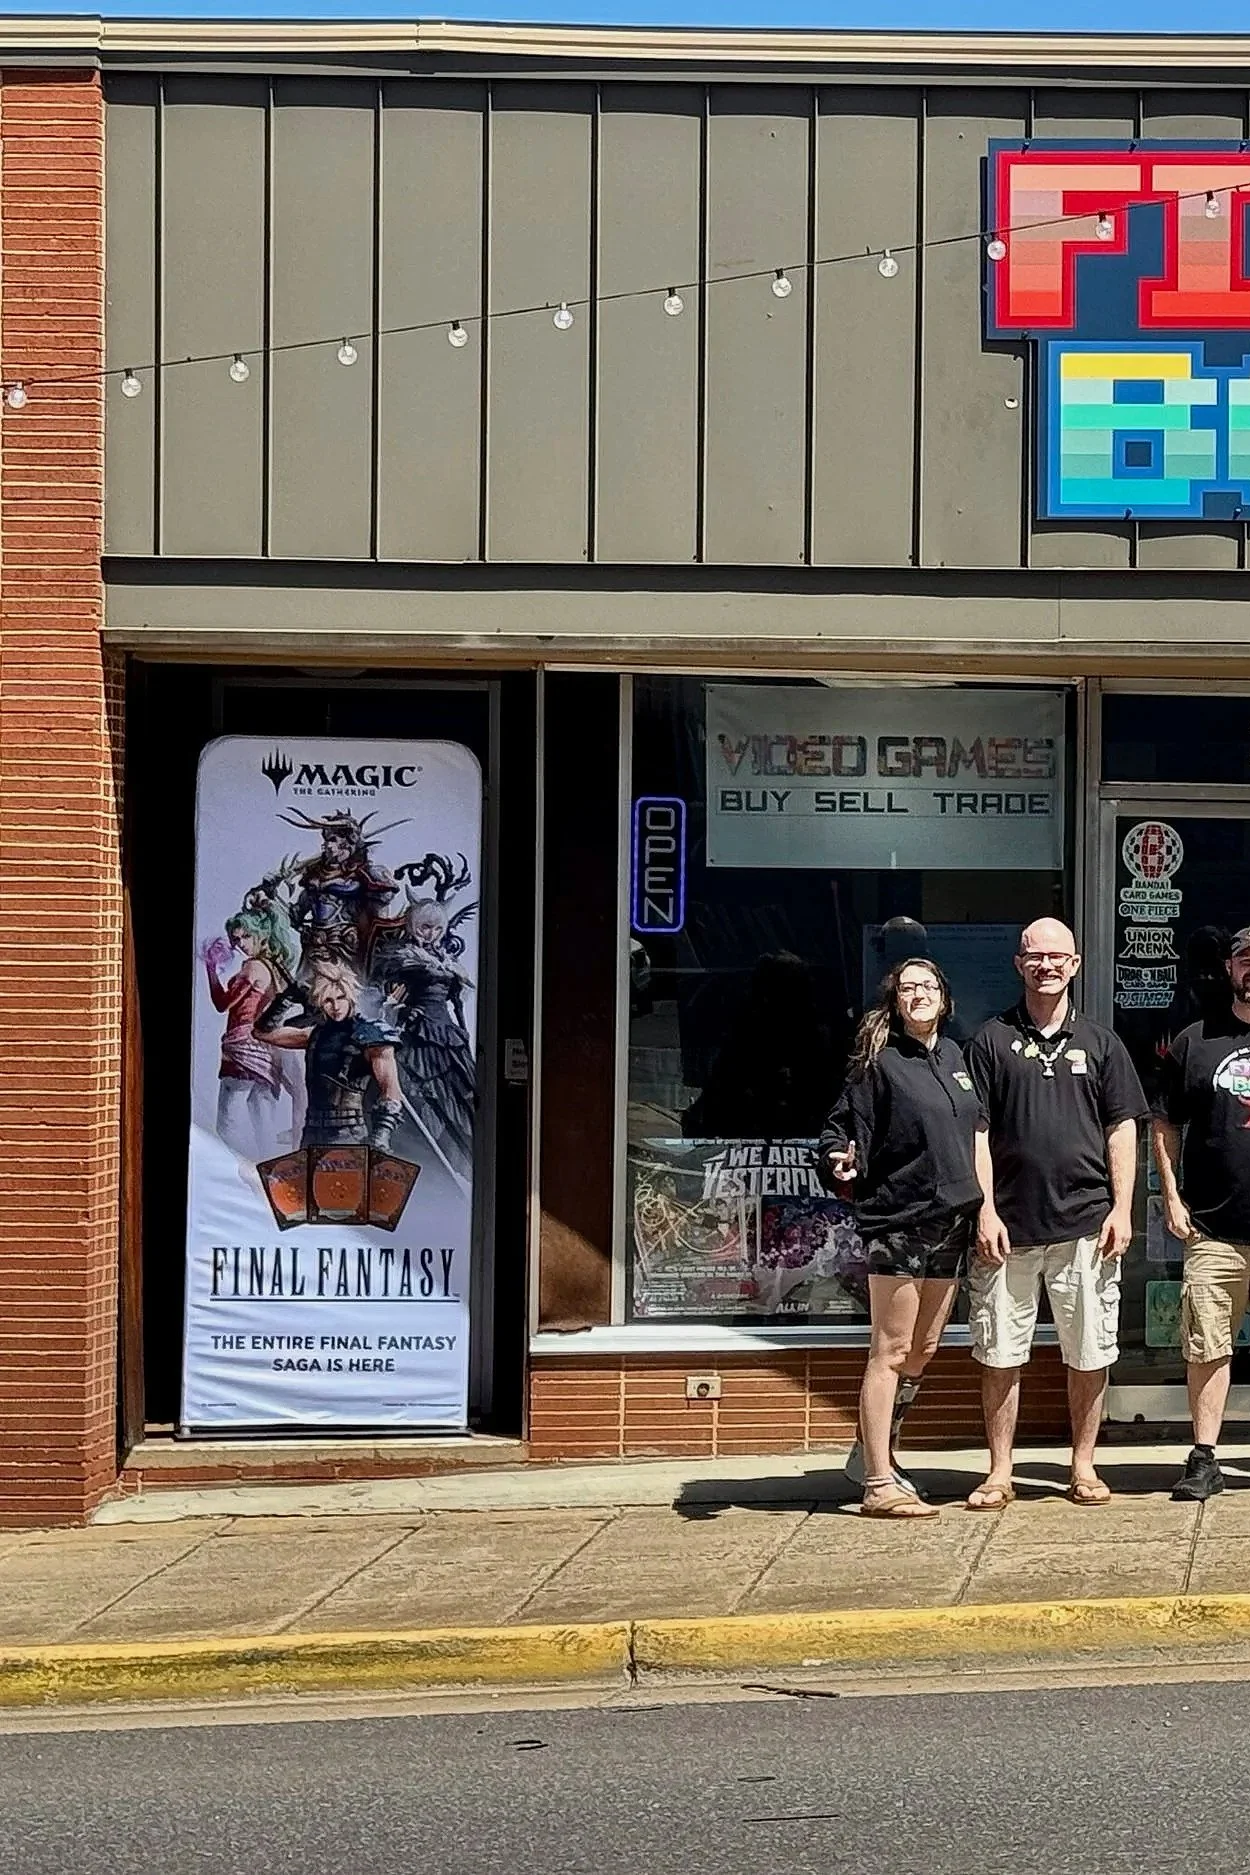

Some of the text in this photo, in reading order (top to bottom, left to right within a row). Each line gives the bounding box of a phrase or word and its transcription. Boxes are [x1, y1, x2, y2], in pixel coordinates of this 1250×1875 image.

[718, 735, 1056, 779] VIDEO GAMES
[293, 764, 417, 789] MAGIC
[293, 787, 376, 797] THE GATHERING
[720, 790, 1050, 815] BUY SELL TRADE
[643, 806, 676, 924] OPEN
[1134, 880, 1169, 889] BANDAI
[1123, 890, 1180, 901] CARD GAMES
[1120, 903, 1146, 915] ONE
[1127, 929, 1172, 942] UNION
[1120, 942, 1179, 958] ARENA
[729, 1147, 813, 1167] WE ARE
[210, 1246, 455, 1298] FINAL FANTASY
[211, 1335, 457, 1351] THE ENTIRE FINAL FANTASY
[272, 1358, 395, 1372] SAGA IS HERE
